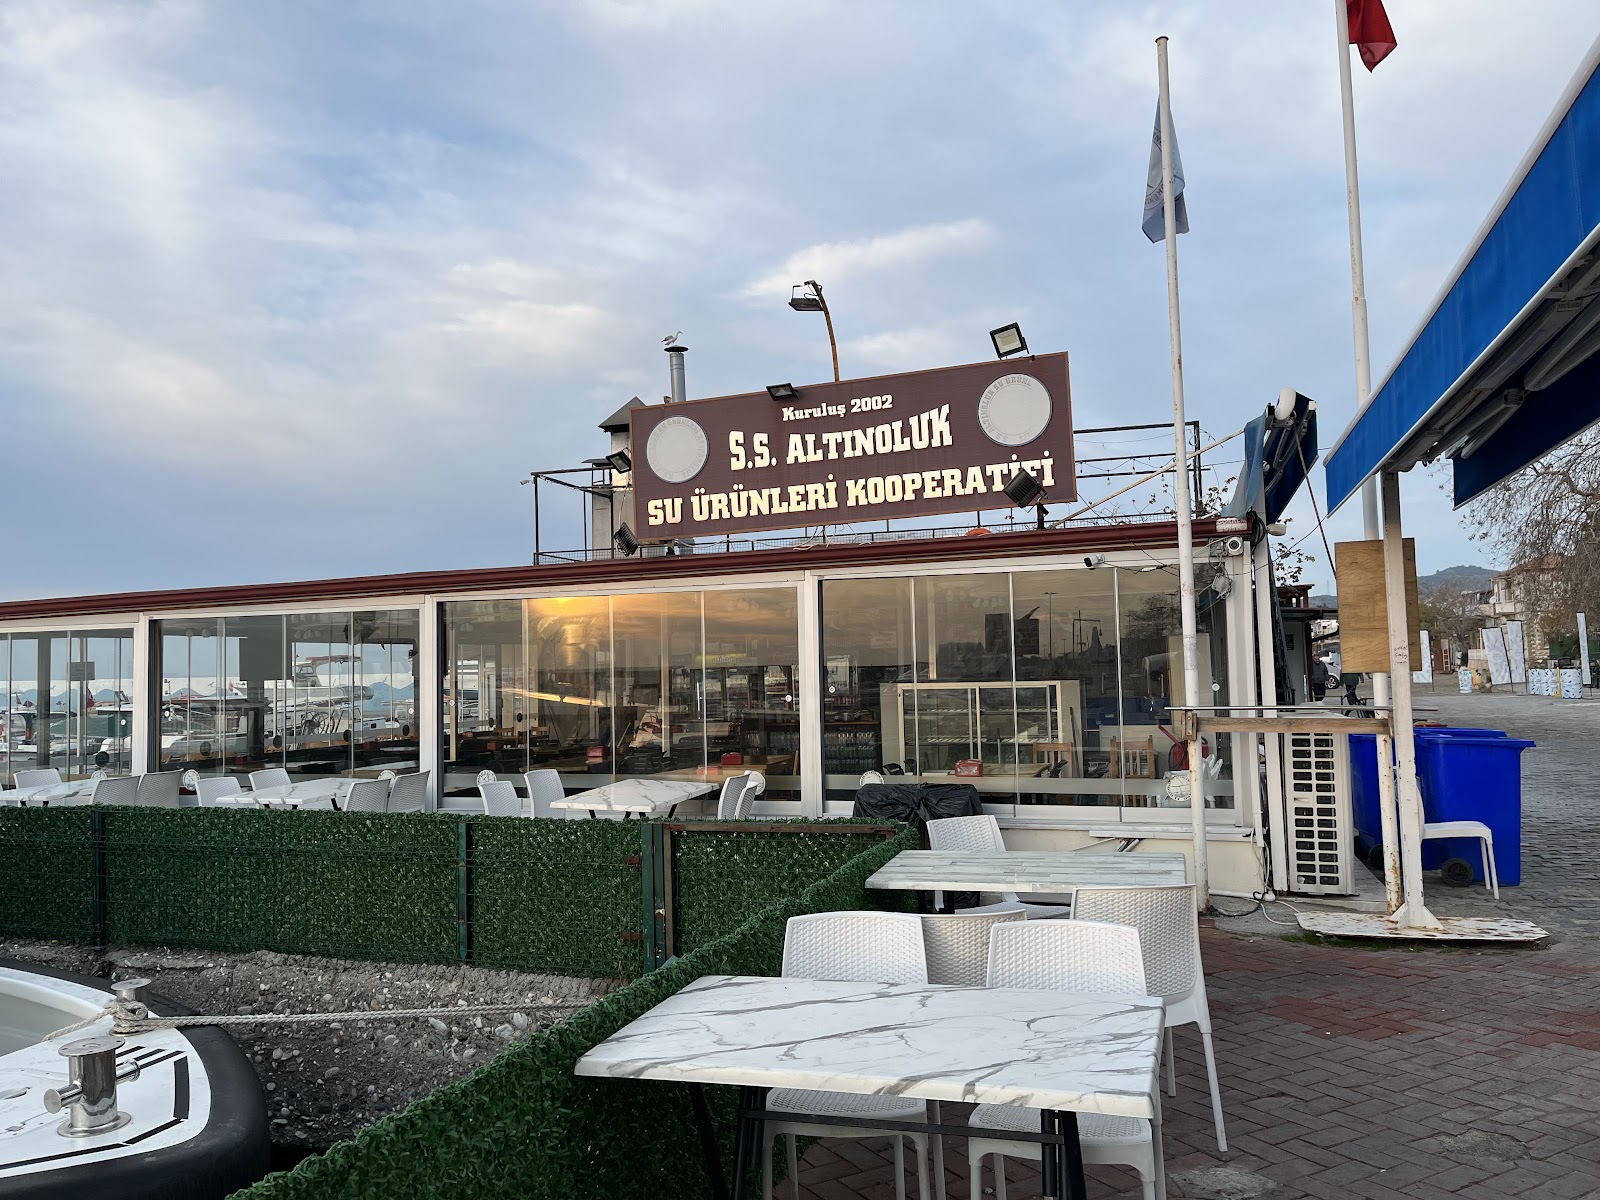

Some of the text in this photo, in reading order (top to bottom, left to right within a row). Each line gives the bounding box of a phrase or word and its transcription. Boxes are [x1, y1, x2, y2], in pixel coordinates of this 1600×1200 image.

[728, 430, 778, 471] S.S.
[786, 403, 953, 466] ALTINOLUK
[781, 394, 893, 422] Kuruluş 2002
[647, 450, 1055, 526] SU ÜRÜNLERİ KOOPERATİFİ
